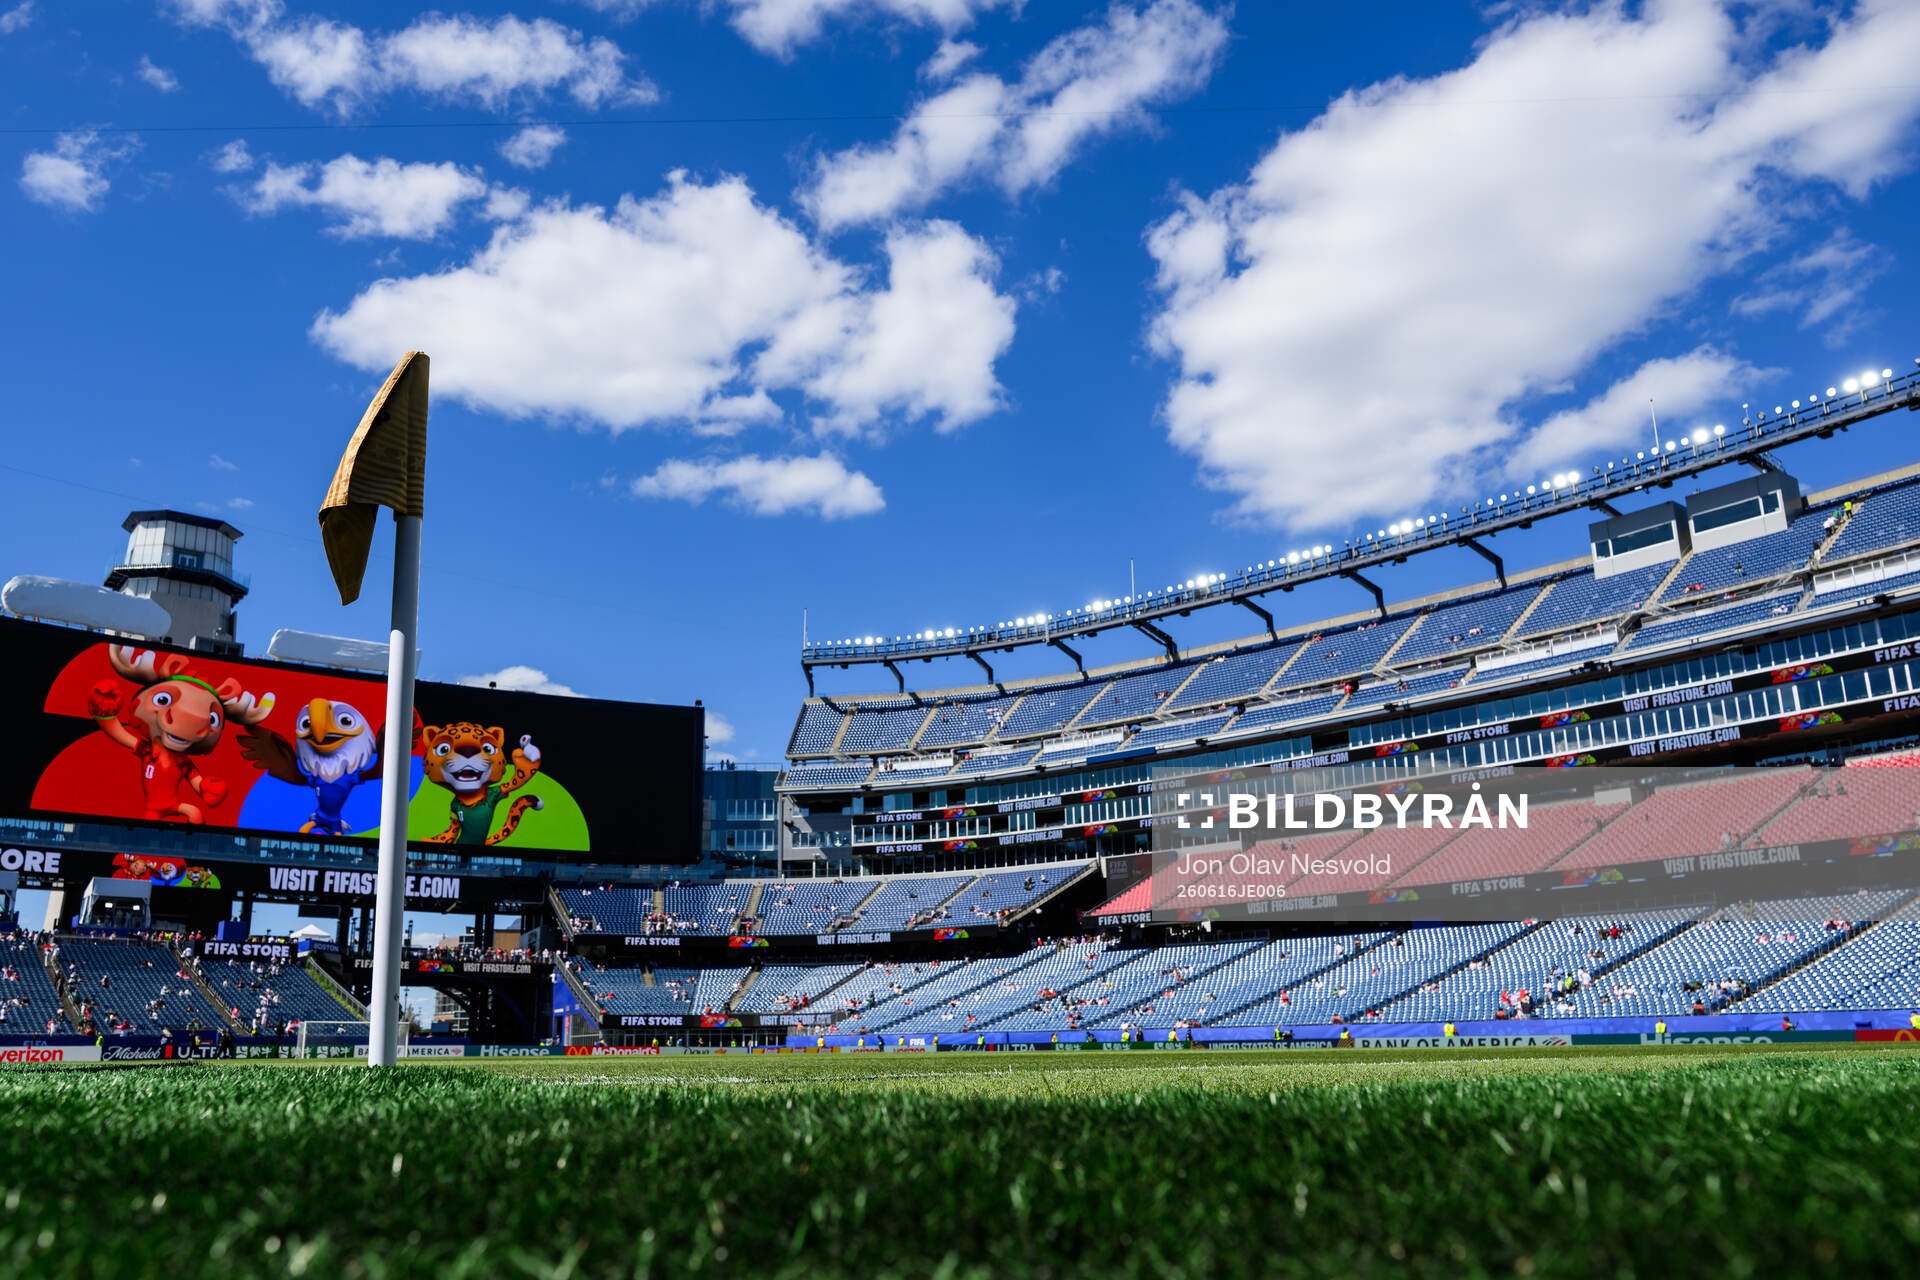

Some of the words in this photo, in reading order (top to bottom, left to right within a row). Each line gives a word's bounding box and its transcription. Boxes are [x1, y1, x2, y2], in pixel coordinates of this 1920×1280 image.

[1874, 645, 1912, 663] FIFA
[1623, 696, 1650, 713] VISIT
[1652, 680, 1733, 708] FIFASTORE.COM
[1883, 695, 1920, 712] FIFA
[1446, 730, 1472, 744] FIFA
[1474, 724, 1510, 739] STORE
[1629, 741, 1656, 757] VISIT
[1659, 726, 1741, 752] FIFASTORE.COM
[1270, 762, 1290, 774] VISIT
[1291, 751, 1349, 771] FIFASTORE.COM
[1451, 772, 1478, 784] FIFA
[1478, 765, 1515, 780] STORE
[1137, 783, 1157, 793] FIFA
[1158, 779, 1186, 790] STORE
[998, 802, 1014, 813] VISIT
[1015, 797, 1062, 811] FIFASTORE.COM
[876, 815, 895, 823] FIFA
[896, 812, 923, 821] STORE
[1140, 818, 1159, 828] FIFA
[1160, 814, 1188, 825] STOE
[999, 834, 1015, 845] VISIT
[1016, 830, 1064, 843] FIFASTORE.COM
[876, 846, 895, 854] FIFA
[896, 843, 923, 852] STORE
[0, 848, 61, 874] ORE
[1663, 857, 1695, 874] VISIT
[1700, 845, 1800, 870] FIFASTORE.COM
[269, 867, 318, 892] VISIT
[323, 871, 460, 899] FIFASTE.COM
[1451, 883, 1480, 895] FIFA
[1483, 877, 1526, 891] STORE
[1247, 901, 1268, 914] VISIT
[1271, 895, 1338, 911] FIFASTORE.COM
[1098, 916, 1119, 925] FIFA
[1120, 913, 1152, 923] STORE
[625, 937, 647, 946] FIFA
[649, 938, 681, 946] STORE
[817, 935, 835, 944] VISIT
[837, 933, 891, 944] FIFASTORE.COM
[204, 942, 238, 955] FIFA
[242, 944, 290, 957] STORE
[463, 963, 480, 972] VISIT
[482, 964, 532, 974] FIFASTORE.COM
[621, 1016, 645, 1026] FIFA
[648, 1016, 683, 1026] STORE
[759, 1015, 778, 1026] VISIT
[909, 1038, 925, 1046] FIFA
[1241, 1042, 1273, 1050] STATES
[1289, 1041, 1333, 1049] AMERICA
[103, 1045, 161, 1061] Michelob
[480, 1045, 549, 1056] Hisense
[592, 1046, 657, 1056] McDonald's
